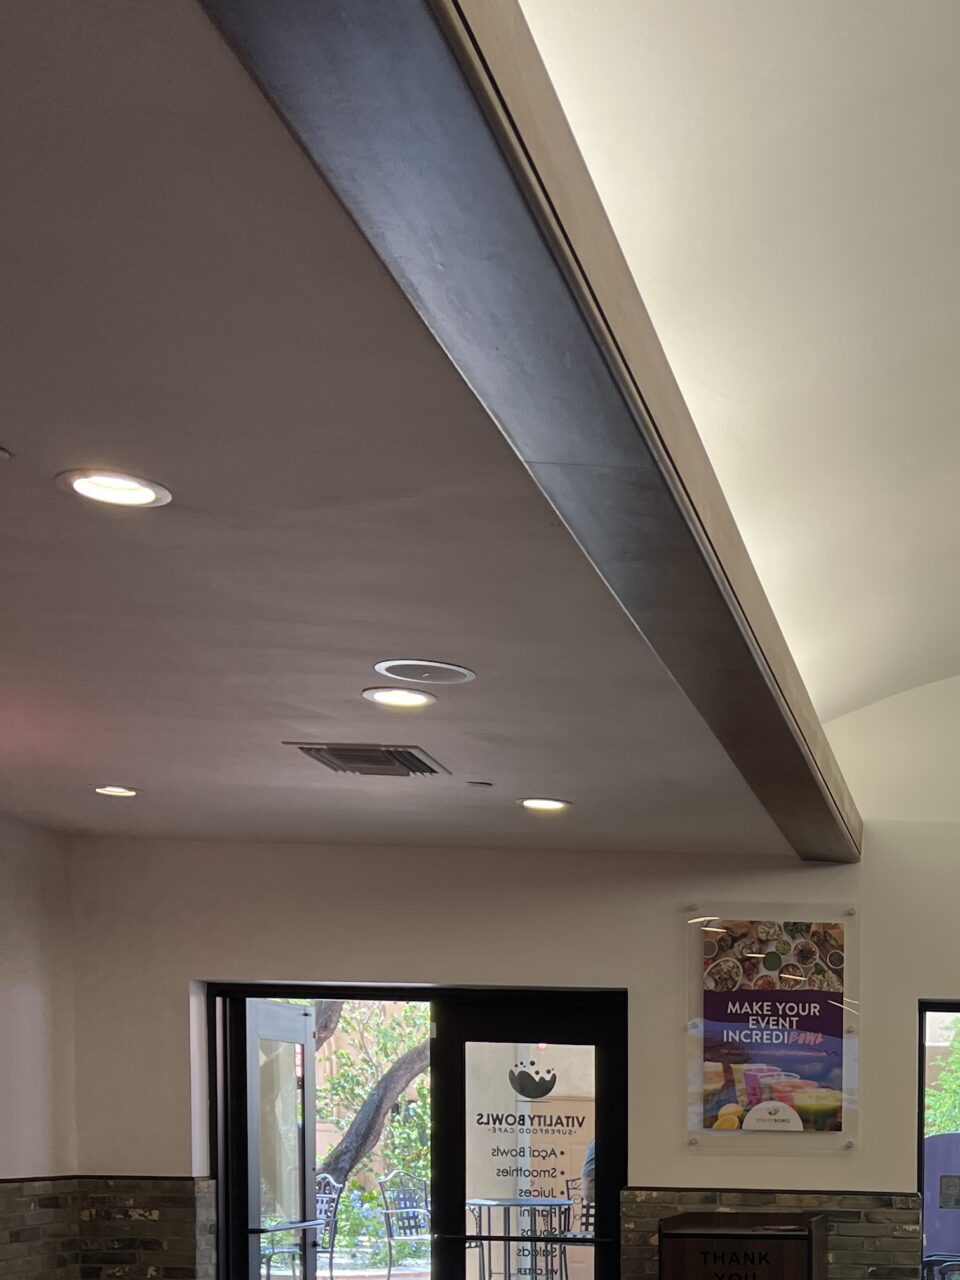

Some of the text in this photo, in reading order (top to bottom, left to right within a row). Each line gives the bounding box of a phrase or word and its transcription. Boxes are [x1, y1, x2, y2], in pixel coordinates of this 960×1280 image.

[727, 1001, 820, 1016] MAKE YOUR
[748, 1016, 799, 1030] EVENT
[701, 1251, 771, 1266] THANK
